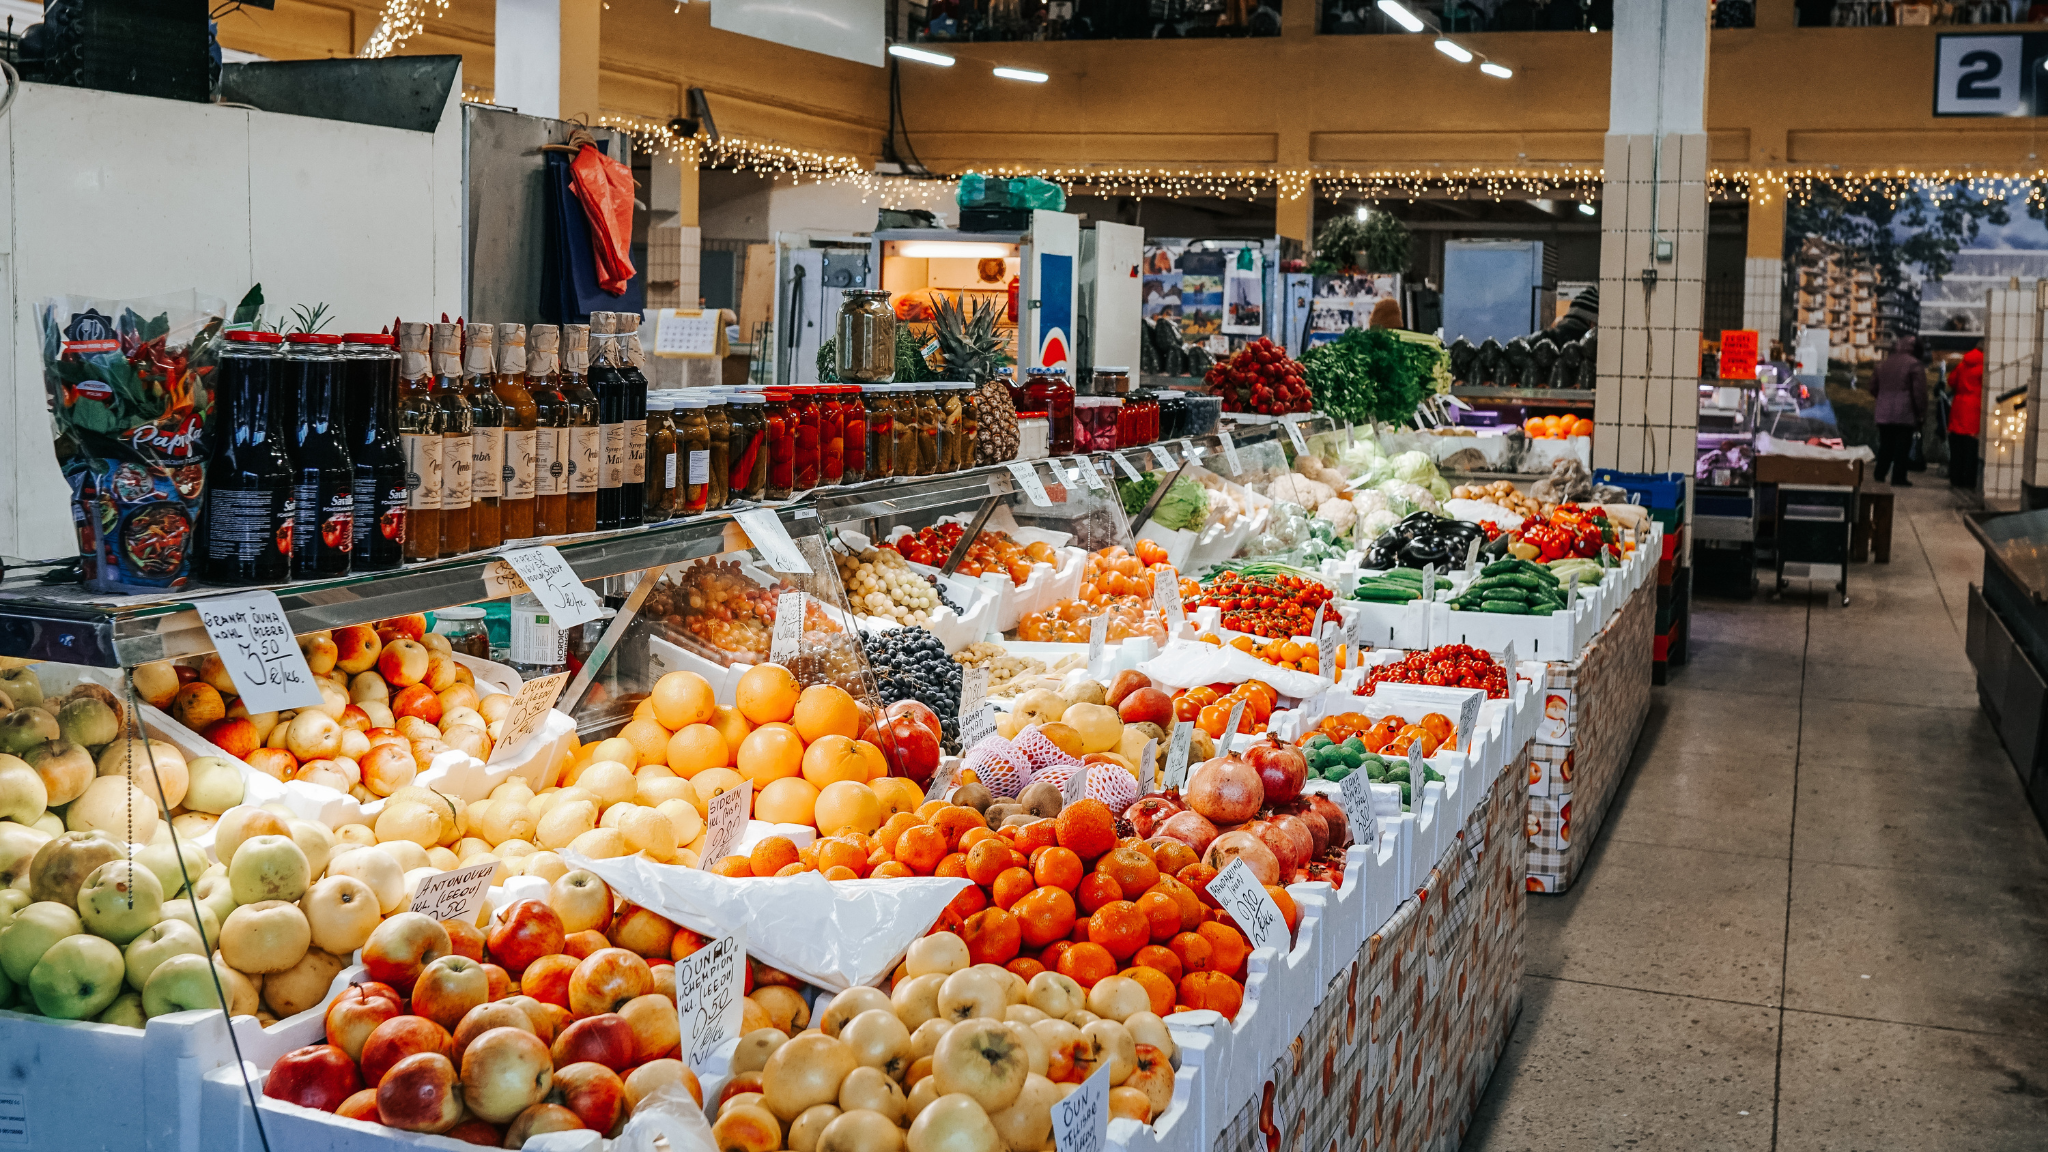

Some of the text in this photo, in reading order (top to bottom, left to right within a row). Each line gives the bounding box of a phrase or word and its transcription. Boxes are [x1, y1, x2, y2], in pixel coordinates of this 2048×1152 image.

[1957, 49, 2003, 100] 2
[204, 612, 246, 628] GRANAT
[557, 629, 565, 662] NORDIC
[709, 789, 742, 814] SIDRUN
[682, 936, 734, 986] ÕUNAD
[1063, 1085, 1089, 1128] ÕUN
